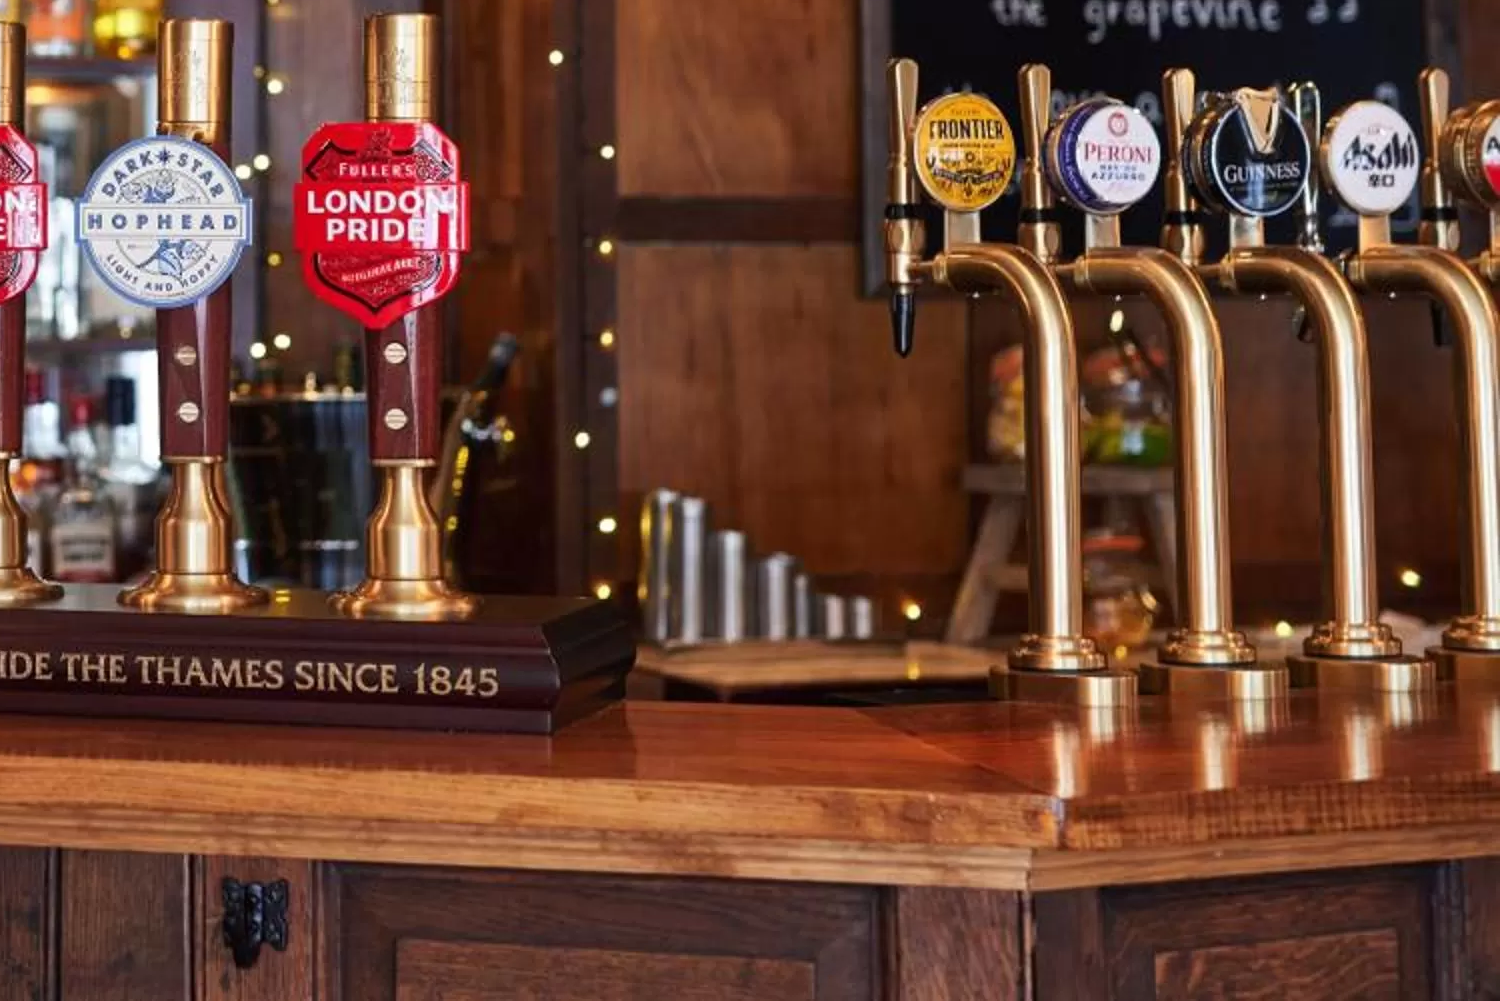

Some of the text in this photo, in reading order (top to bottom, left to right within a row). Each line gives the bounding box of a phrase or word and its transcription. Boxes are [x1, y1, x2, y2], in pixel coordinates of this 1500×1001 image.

[929, 119, 1004, 140] FRONTIER
[1085, 142, 1151, 164] PERONI
[1343, 132, 1416, 171] Asahi
[102, 151, 224, 197] DARK STAR
[339, 162, 413, 177] FULLER'S
[1224, 162, 1300, 184] GUINNESS
[307, 189, 452, 215] LONDON
[87, 214, 238, 230] HOPHEAD
[326, 218, 426, 242] PRIDE
[106, 254, 219, 292] LIGHT AND HOPPY
[60, 653, 127, 684] THE
[135, 655, 285, 690] THAMES
[295, 661, 400, 694] SINCE
[413, 662, 499, 697] 1845
